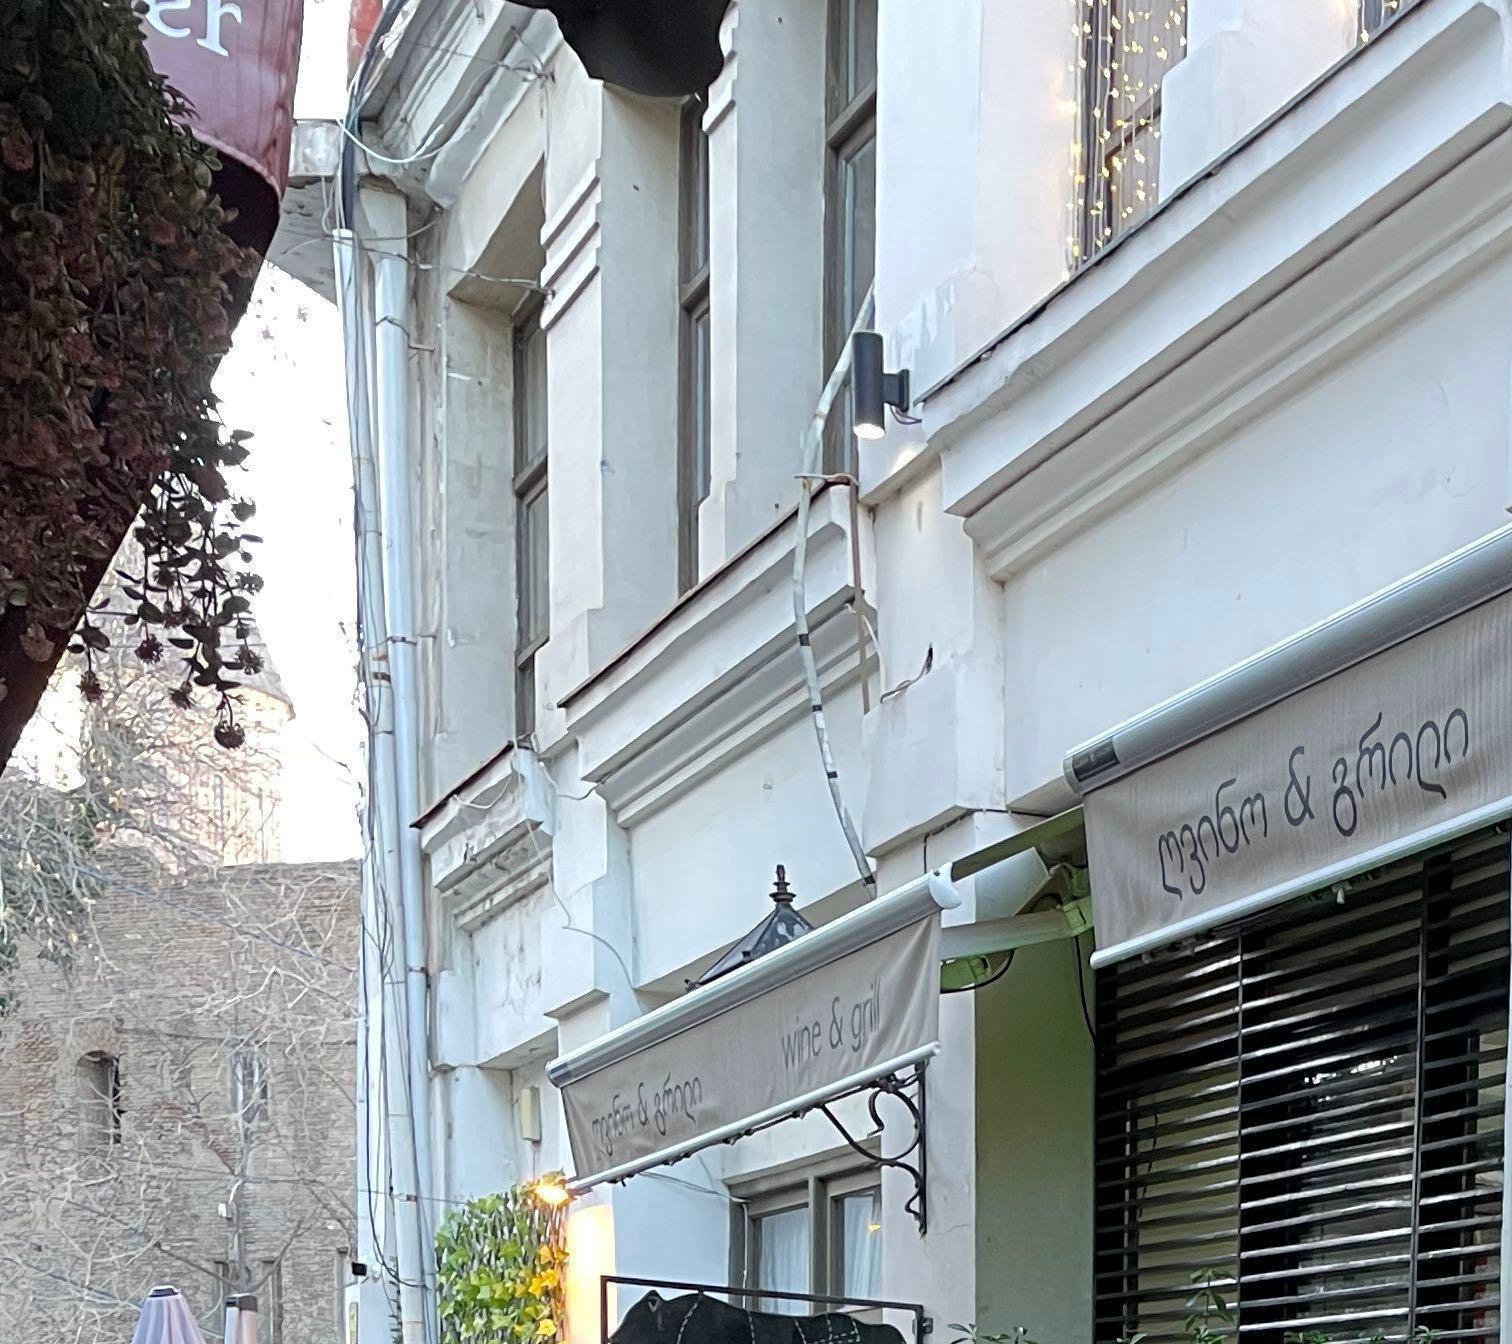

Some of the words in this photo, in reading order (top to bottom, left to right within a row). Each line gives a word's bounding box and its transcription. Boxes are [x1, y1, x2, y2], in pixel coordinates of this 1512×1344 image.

[1158, 777, 1268, 900] ღვინო
[1284, 746, 1314, 826] &
[1332, 711, 1469, 836] გრილი
[781, 1015, 821, 1069] wine
[829, 996, 843, 1049] &
[851, 977, 881, 1053] grill
